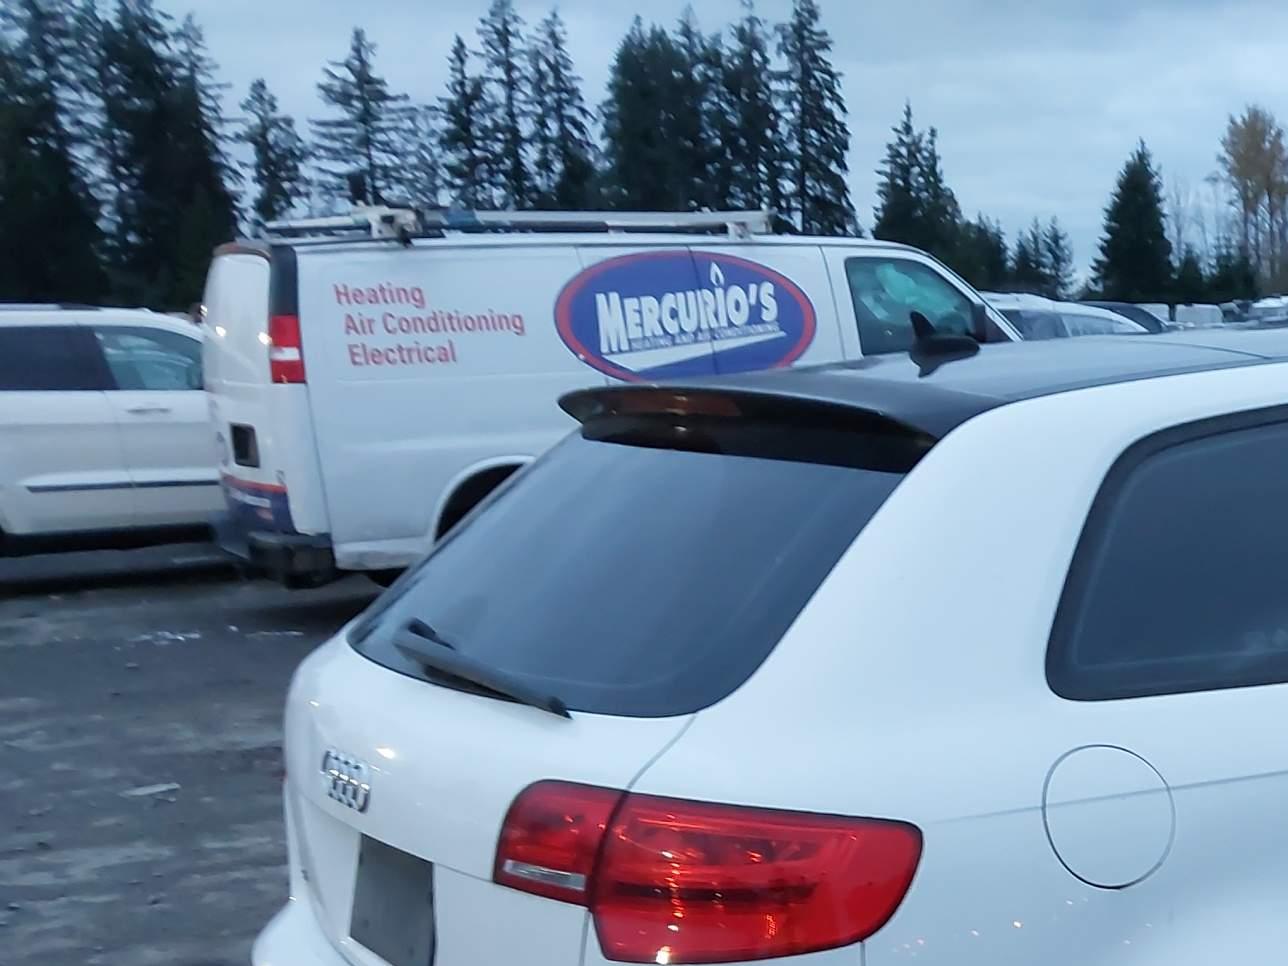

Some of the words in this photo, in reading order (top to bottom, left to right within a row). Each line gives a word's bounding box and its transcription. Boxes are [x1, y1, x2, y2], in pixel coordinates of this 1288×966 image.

[333, 282, 426, 308] Heating
[344, 312, 375, 335] Air
[382, 308, 526, 336] Conditioning
[595, 281, 778, 353] MERCURIO'S
[347, 339, 457, 366] Electrical
